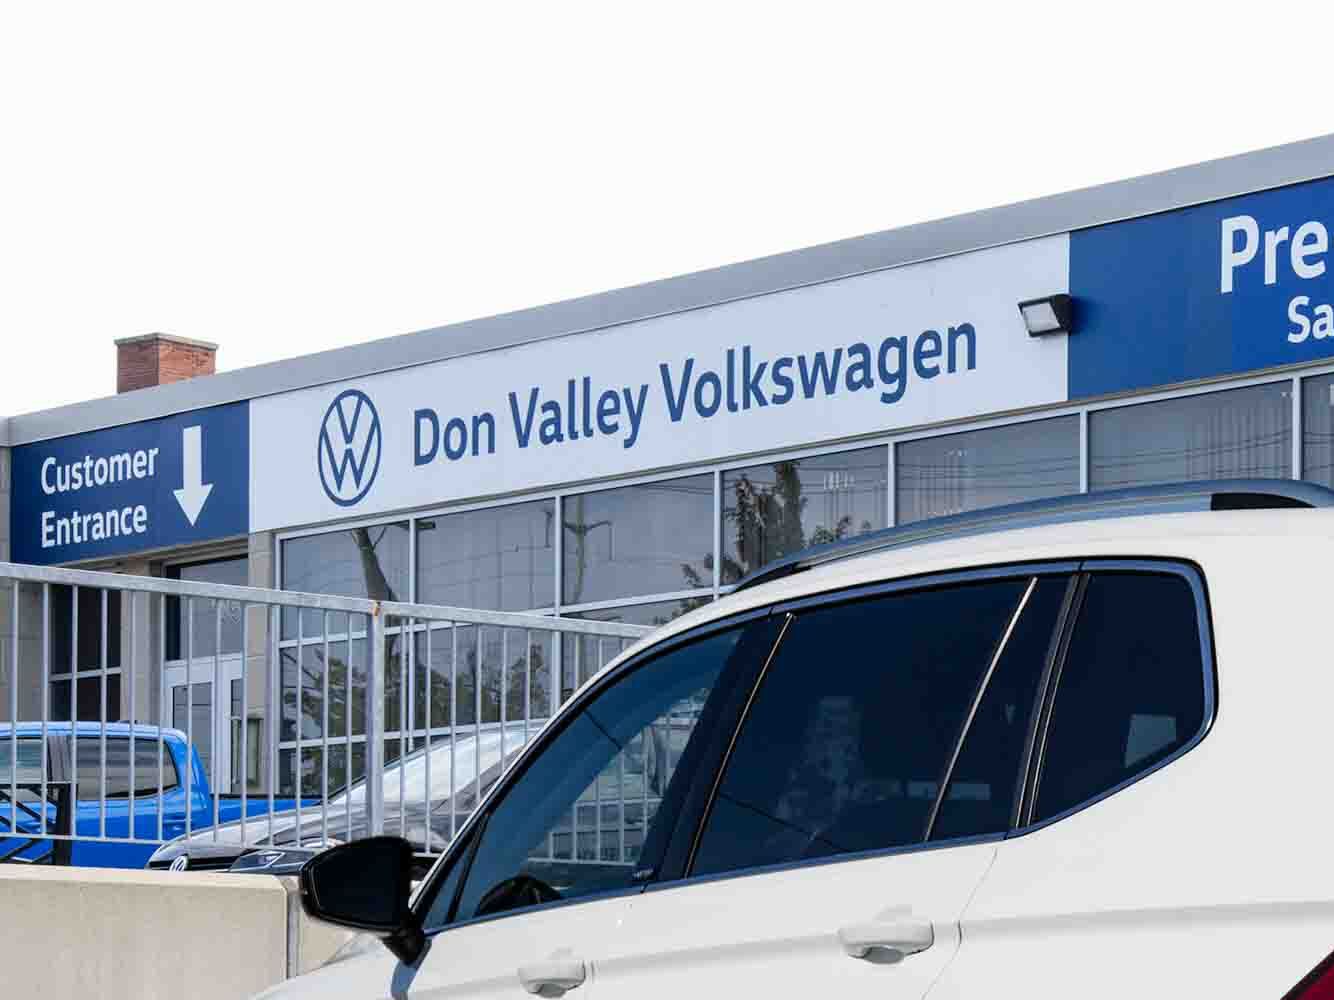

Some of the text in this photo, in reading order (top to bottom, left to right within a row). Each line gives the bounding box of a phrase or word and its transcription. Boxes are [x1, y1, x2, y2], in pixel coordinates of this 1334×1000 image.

[413, 322, 977, 467] Don Valley Volkswagen
[41, 447, 159, 495] Customer
[41, 504, 148, 548] Entrance
